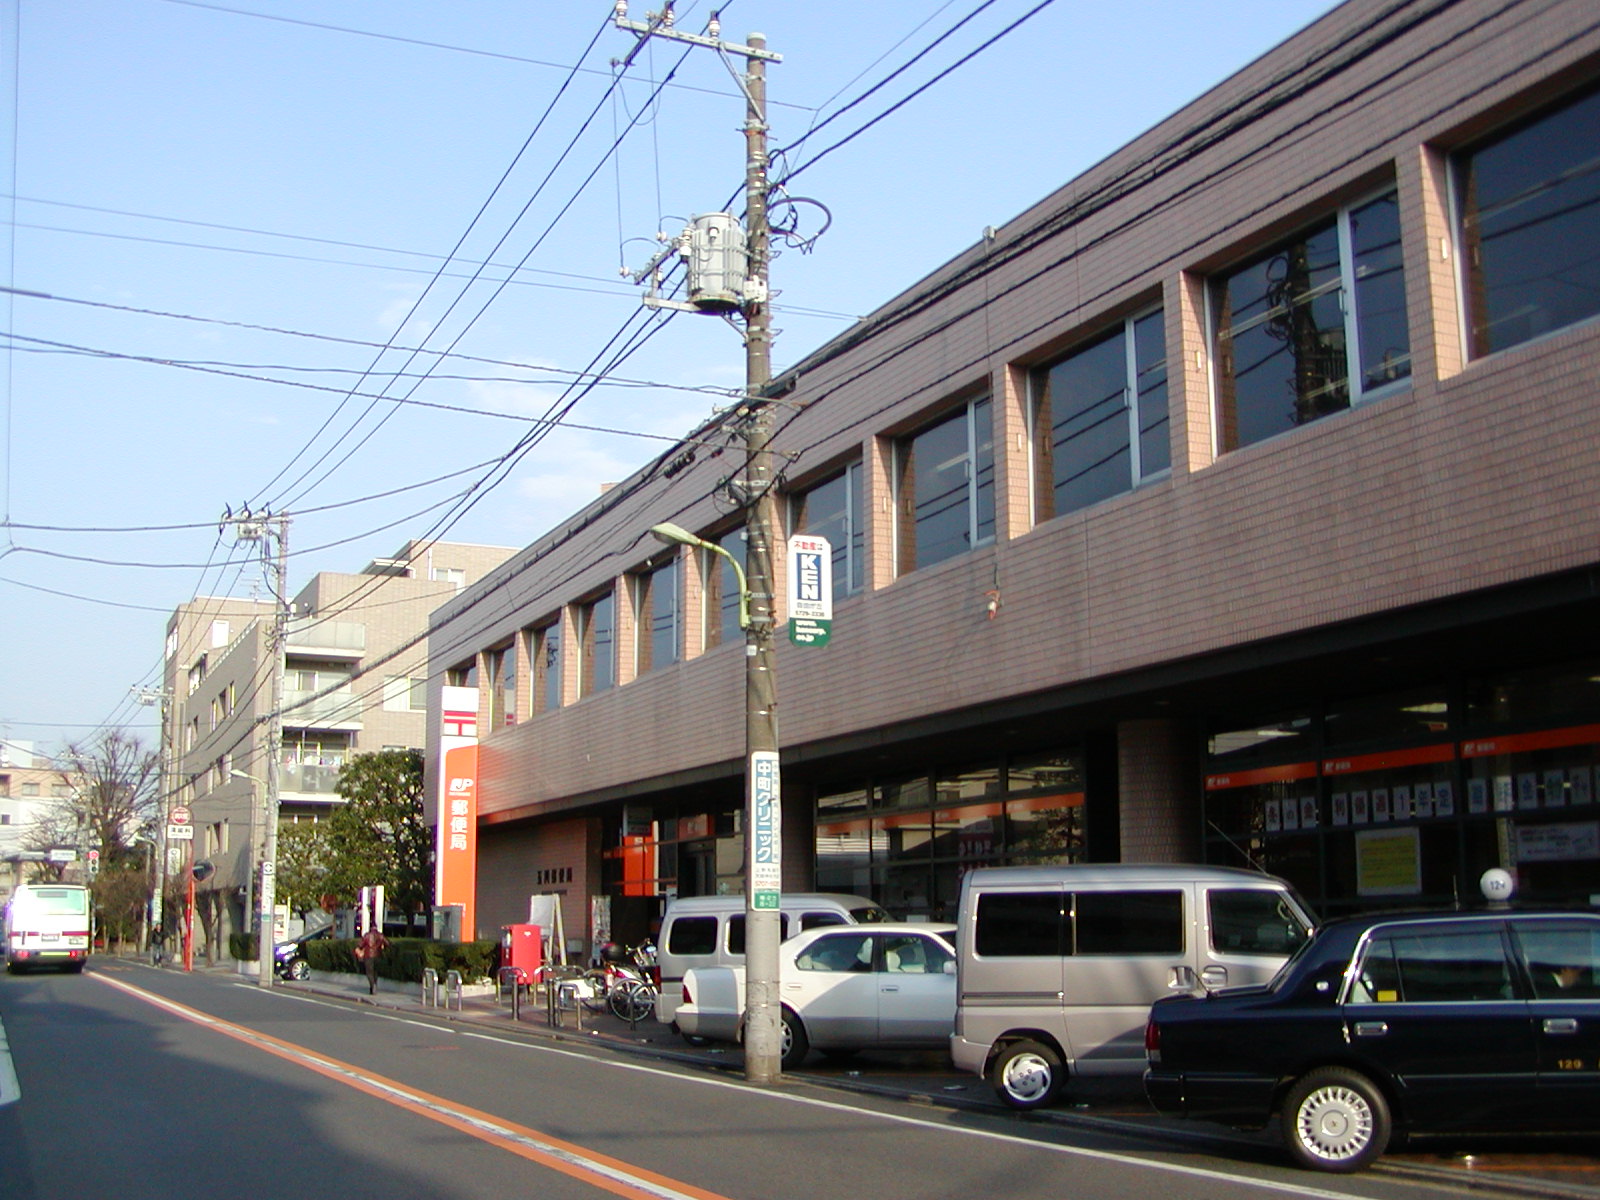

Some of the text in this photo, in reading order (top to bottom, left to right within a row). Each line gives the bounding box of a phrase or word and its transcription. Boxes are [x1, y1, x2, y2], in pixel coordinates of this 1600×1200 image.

[801, 554, 819, 600] KEN
[450, 799, 469, 851] 郵便局
[757, 761, 772, 862] 中町クリニック
